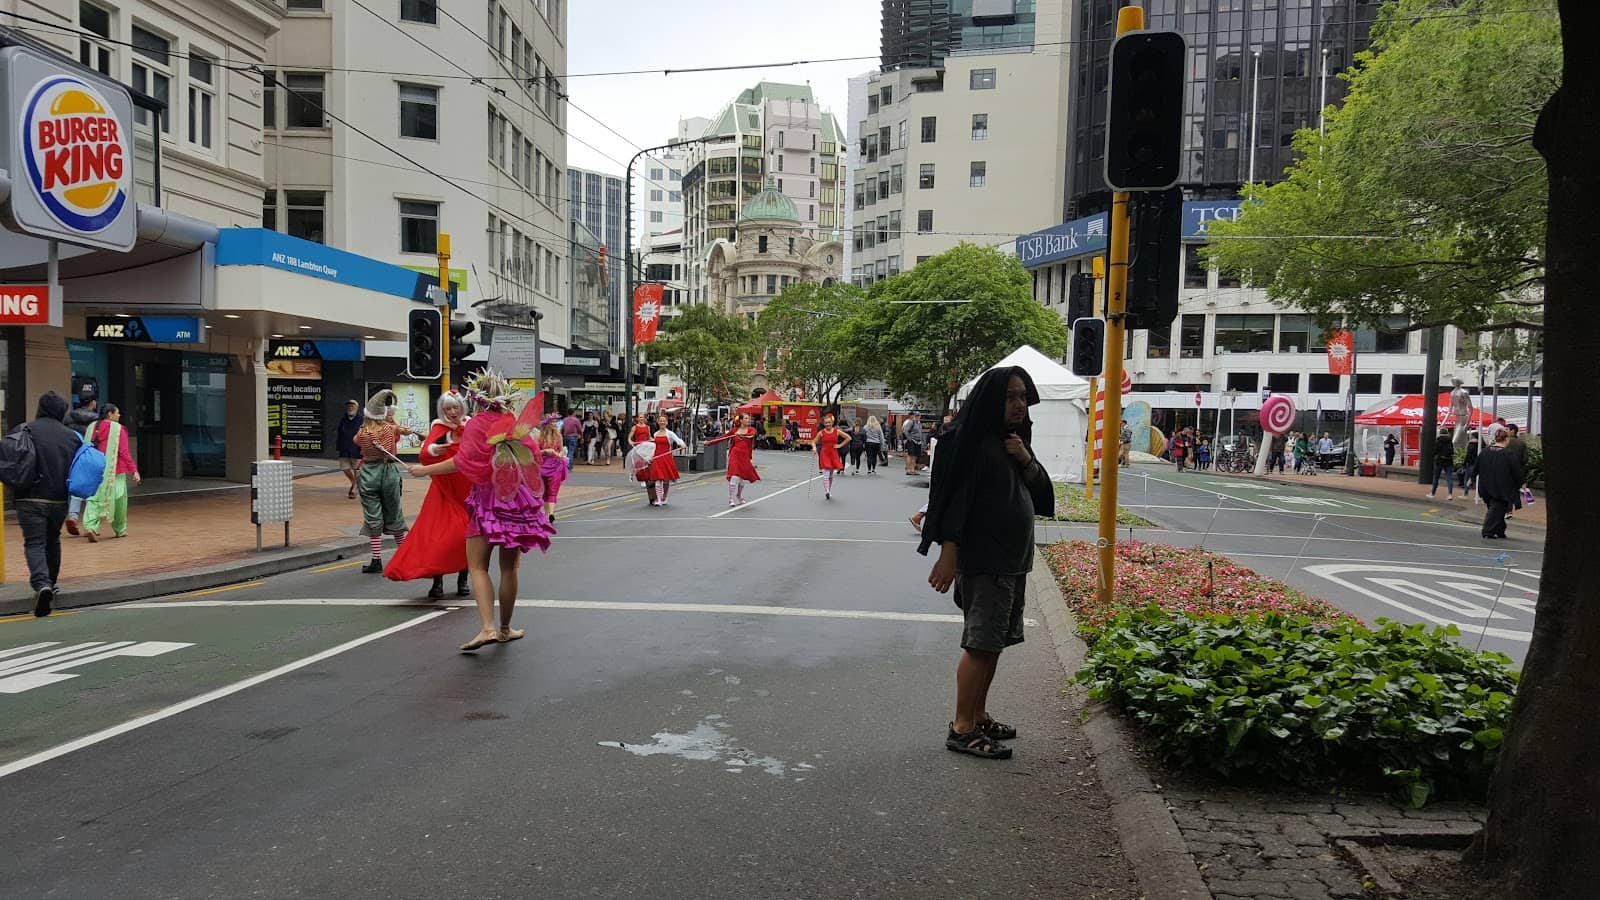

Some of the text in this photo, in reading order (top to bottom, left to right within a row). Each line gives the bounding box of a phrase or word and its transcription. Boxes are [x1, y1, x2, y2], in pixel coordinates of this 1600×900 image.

[38, 116, 119, 150] BURGER
[43, 143, 123, 190] KING
[1018, 227, 1079, 262] TSB Bank
[272, 253, 337, 278] ANZ 188 Lambton Quay
[1114, 291, 1121, 301] 2
[93, 324, 125, 338] ANZ
[175, 331, 191, 339] ATM
[274, 345, 300, 357] ANZ
[272, 385, 292, 393] office
[293, 385, 321, 393] location
